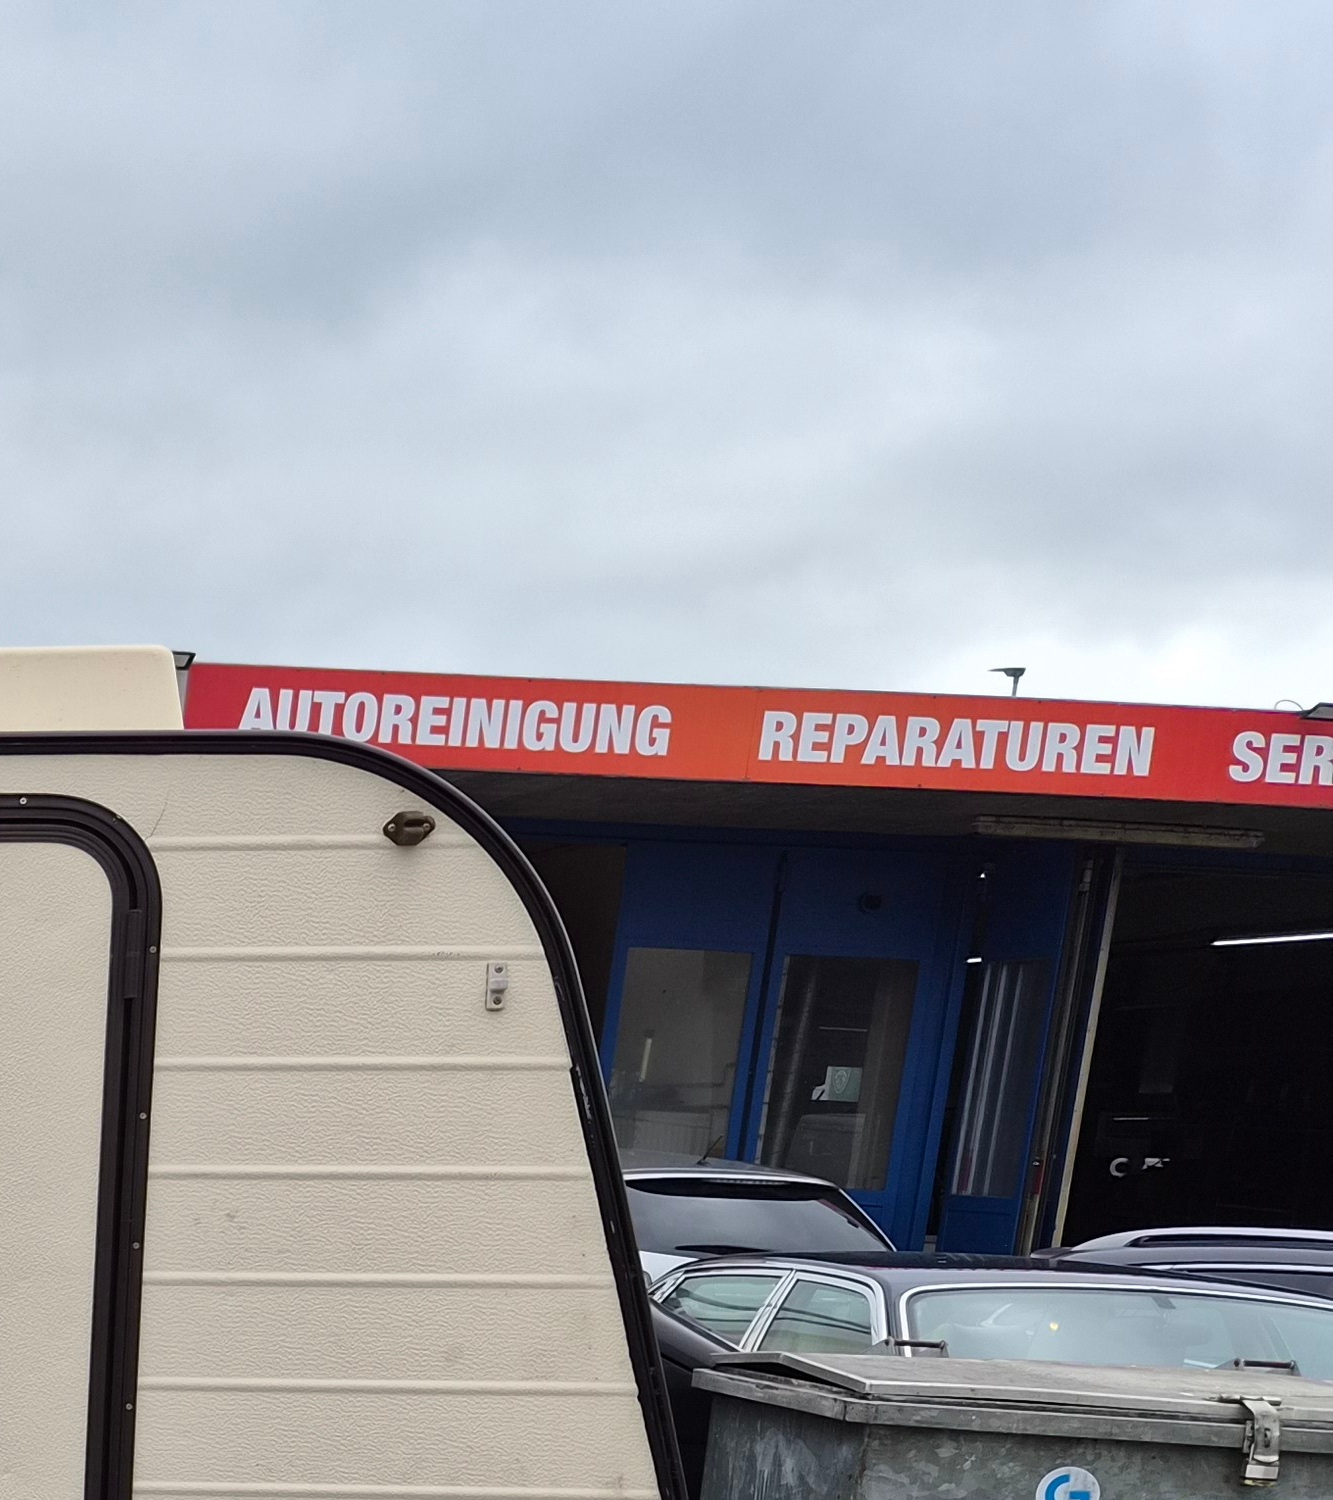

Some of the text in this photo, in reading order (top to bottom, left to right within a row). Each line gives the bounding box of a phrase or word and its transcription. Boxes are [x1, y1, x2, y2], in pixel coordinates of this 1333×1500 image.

[238, 687, 1333, 786] AUTOREINIGUNG REPARATUREN SER
